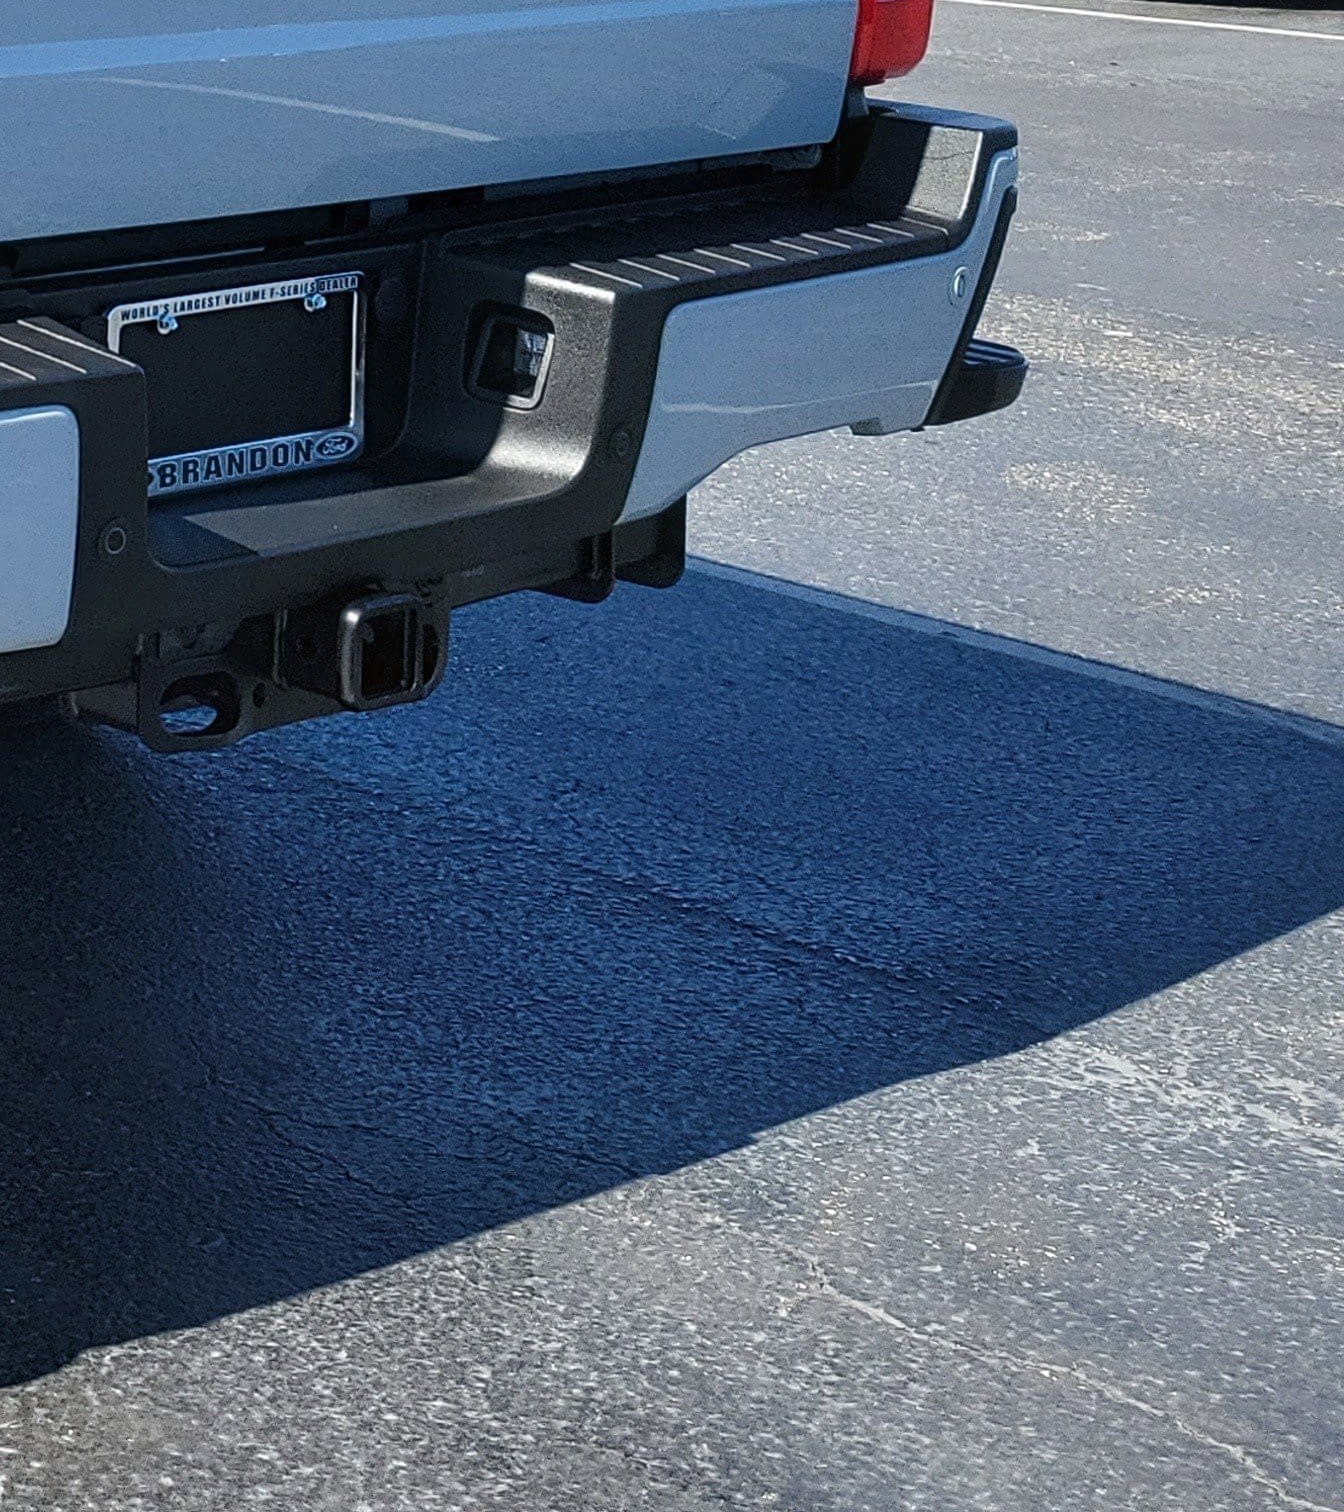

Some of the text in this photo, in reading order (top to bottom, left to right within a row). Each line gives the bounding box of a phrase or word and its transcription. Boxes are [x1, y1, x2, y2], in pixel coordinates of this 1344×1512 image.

[121, 275, 359, 321] WORLD'S LARGEST VOLUME F-SERIES DEALER
[157, 437, 348, 489] BRANDON Ford
